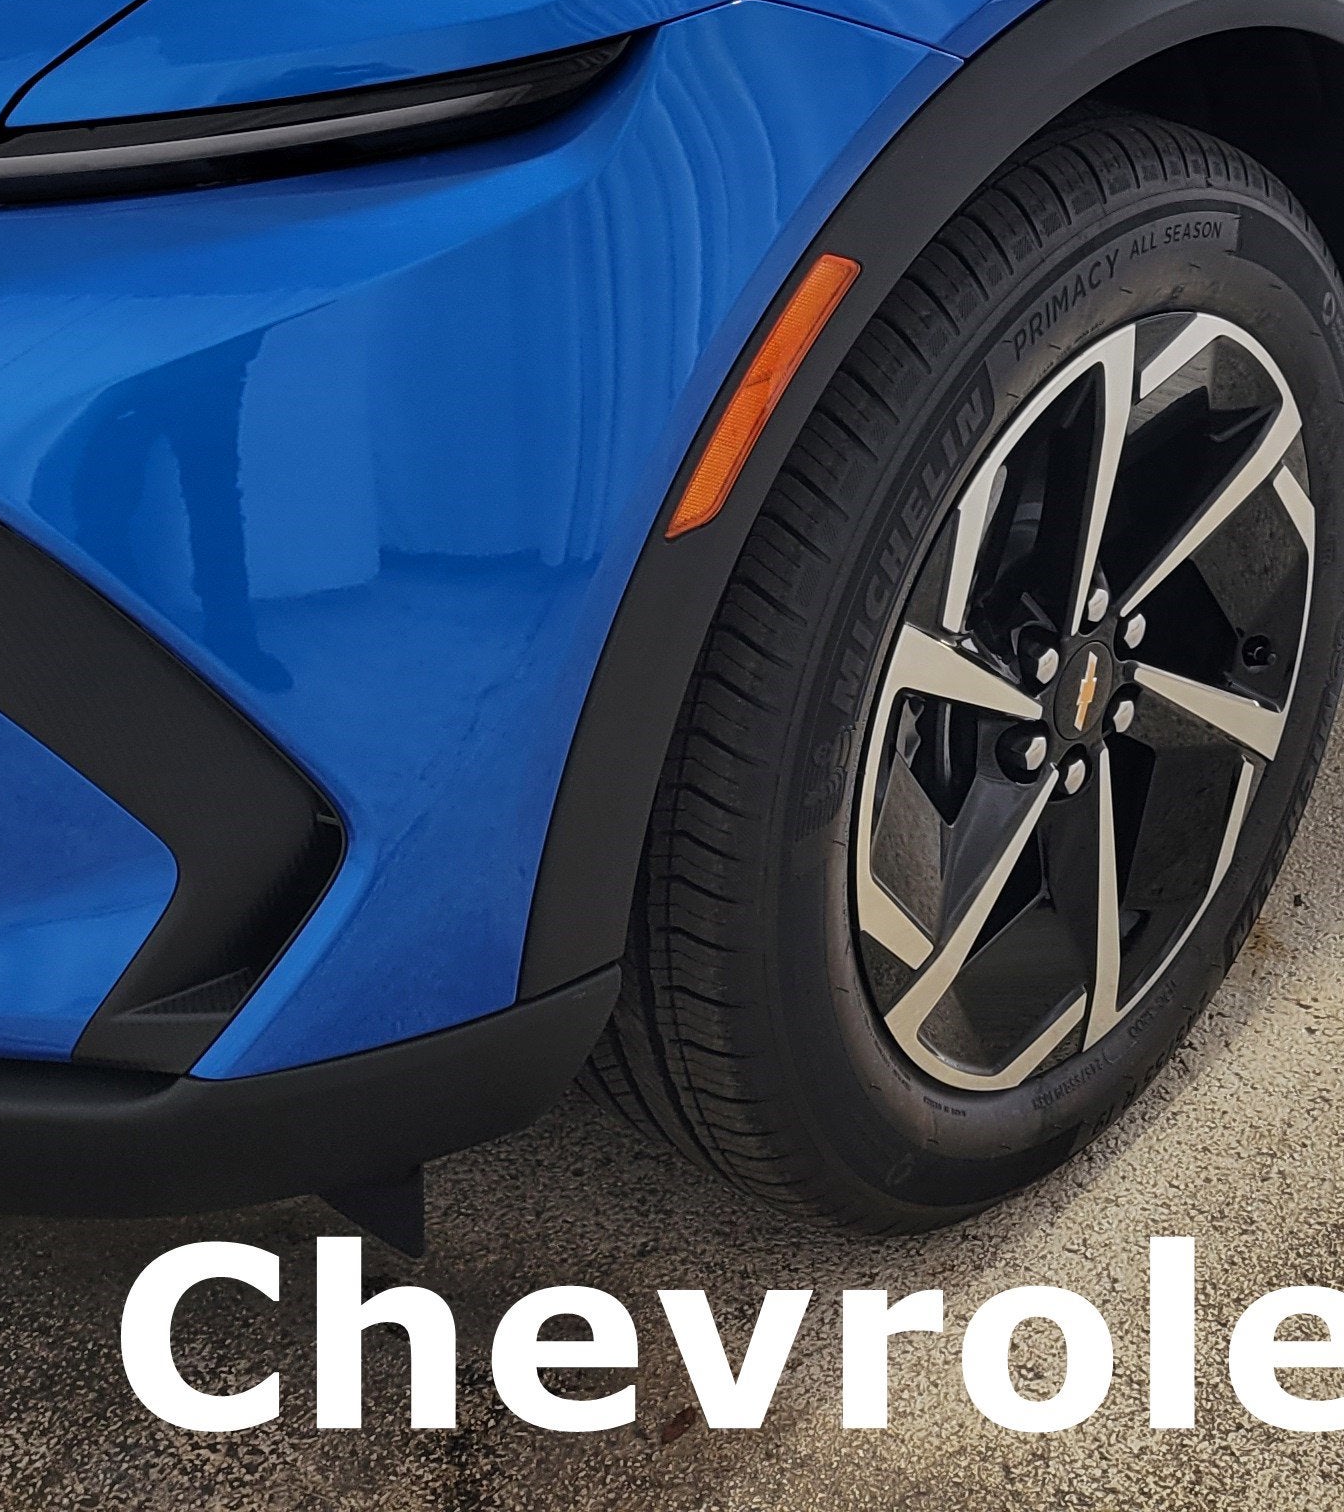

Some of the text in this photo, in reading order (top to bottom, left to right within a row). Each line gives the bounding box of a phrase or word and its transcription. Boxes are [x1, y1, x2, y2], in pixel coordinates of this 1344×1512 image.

[1011, 221, 1223, 360] PRIMACY ALL SEASON
[832, 387, 986, 715] MICHELIN
